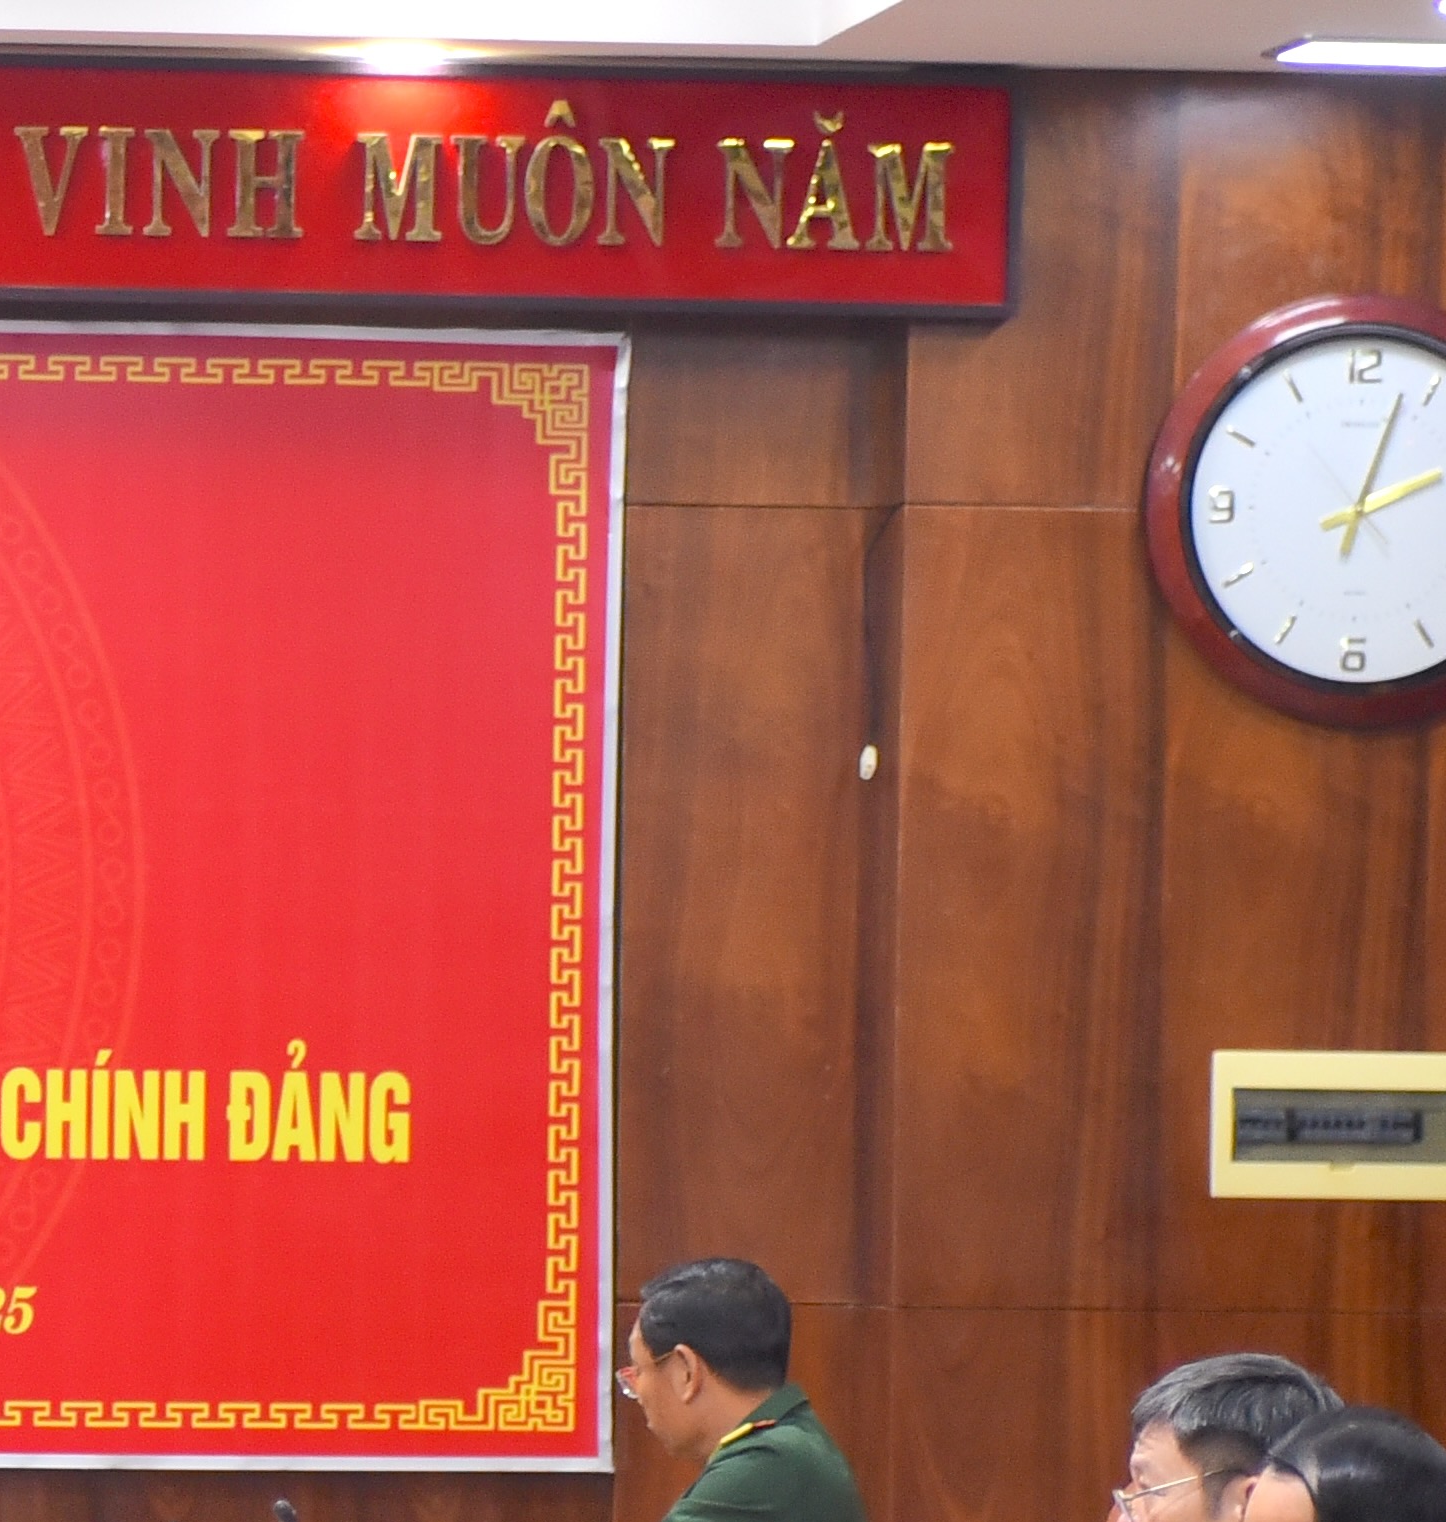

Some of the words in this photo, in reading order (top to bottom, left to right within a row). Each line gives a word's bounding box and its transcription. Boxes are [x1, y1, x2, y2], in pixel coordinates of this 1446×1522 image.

[14, 125, 305, 238] VINH
[353, 100, 675, 247] MUÔN
[714, 110, 956, 252] NĂM
[1347, 349, 1383, 384] 12
[1208, 484, 1235, 523] 9
[1338, 637, 1366, 672] 6
[1, 1050, 205, 1160] CHÍNH
[227, 1040, 409, 1162] ĐẢNG
